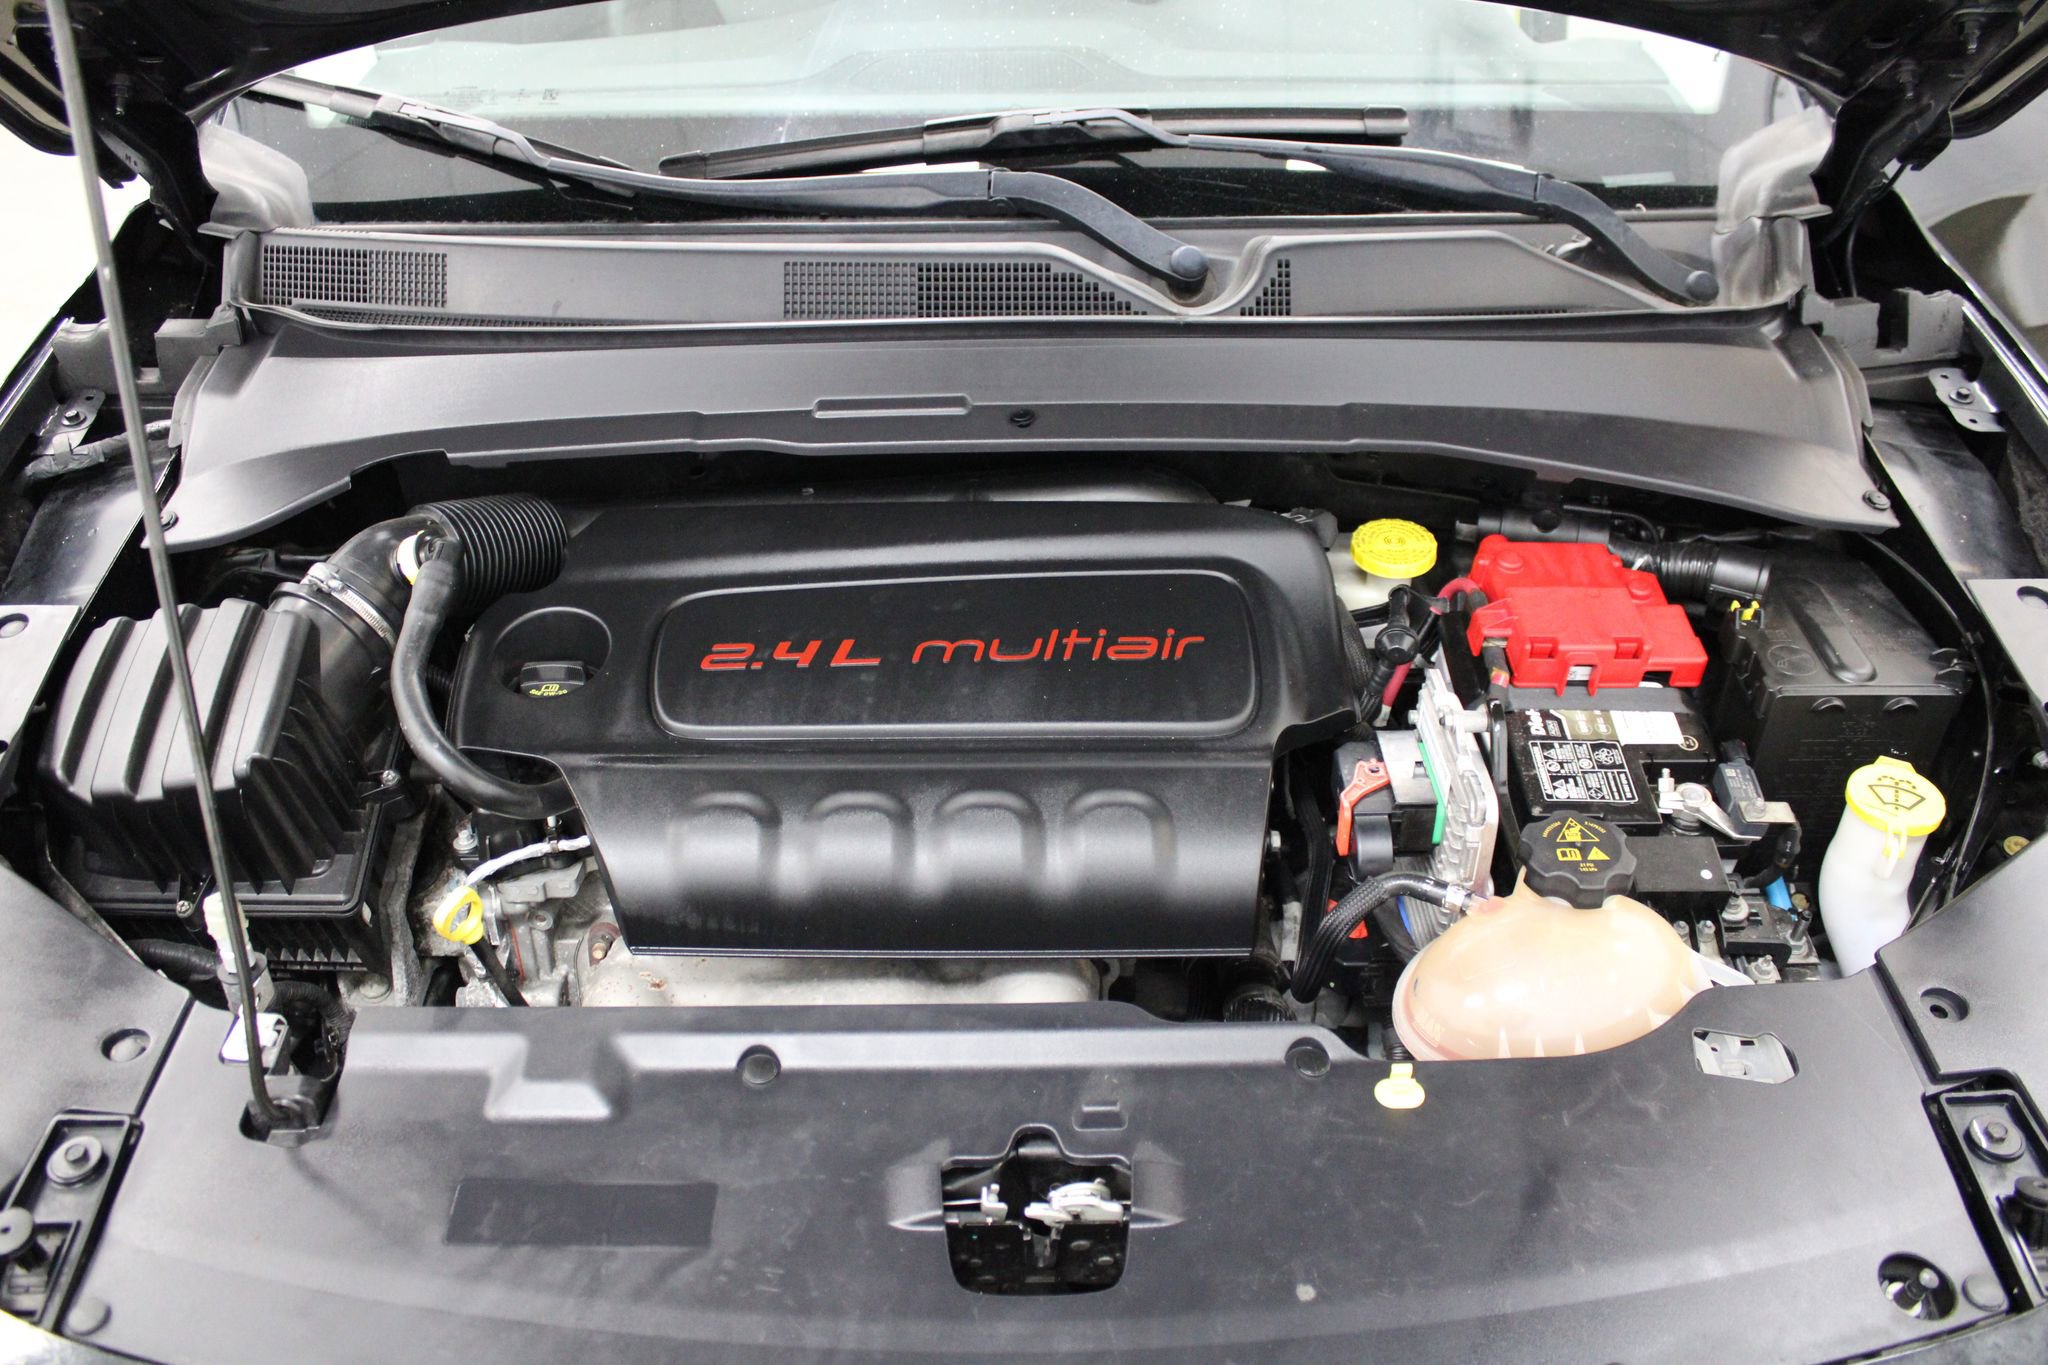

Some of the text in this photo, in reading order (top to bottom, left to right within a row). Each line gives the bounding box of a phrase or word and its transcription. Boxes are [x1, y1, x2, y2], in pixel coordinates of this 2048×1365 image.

[700, 628, 1205, 670] 2.4 L multiair
